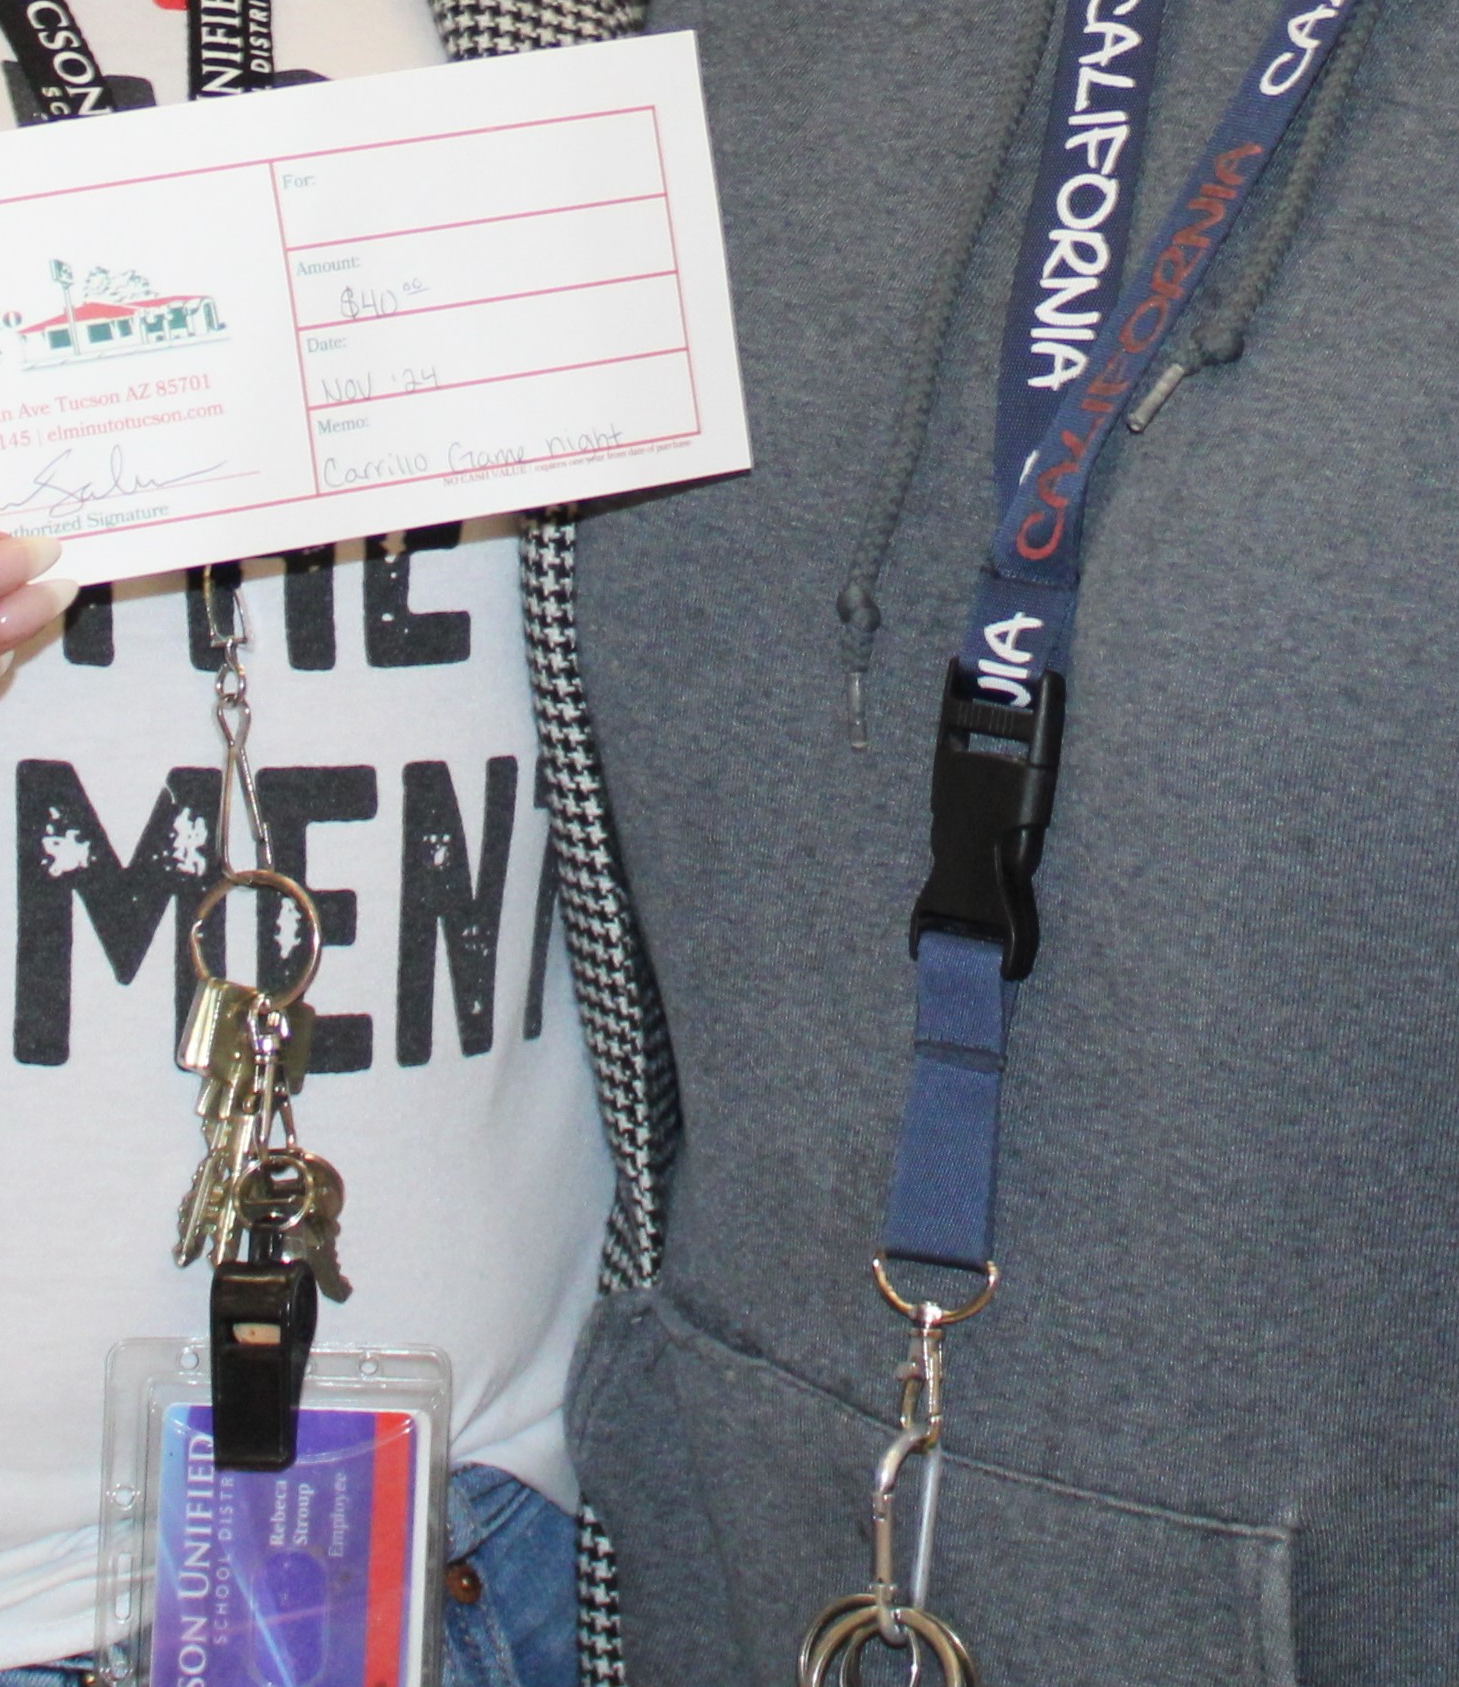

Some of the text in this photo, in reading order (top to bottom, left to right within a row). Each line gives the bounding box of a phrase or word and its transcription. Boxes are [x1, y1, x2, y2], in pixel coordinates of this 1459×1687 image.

[281, 173, 316, 190] For:
[295, 255, 362, 278] Amount:
[340, 284, 398, 321] $40
[306, 335, 348, 354] Date:
[1015, 142, 1265, 562] CALIFORNIA
[17, 402, 51, 420] Ave
[55, 393, 121, 413] Tucson
[126, 382, 152, 402] AZ
[155, 373, 212, 397] 85701
[47, 402, 225, 442] elminutotucson.com
[317, 414, 370, 435] Memo:
[323, 452, 429, 489] Carrillo
[460, 470, 489, 484] CASH
[490, 464, 527, 479] VALUE
[10, 504, 171, 538] thorized Signature
[177, 1433, 214, 1601] UNIFIED
[292, 1482, 316, 1547] Stroup
[328, 1471, 351, 1559] Employee
[213, 1476, 234, 1645] SCHOOL DISTR
